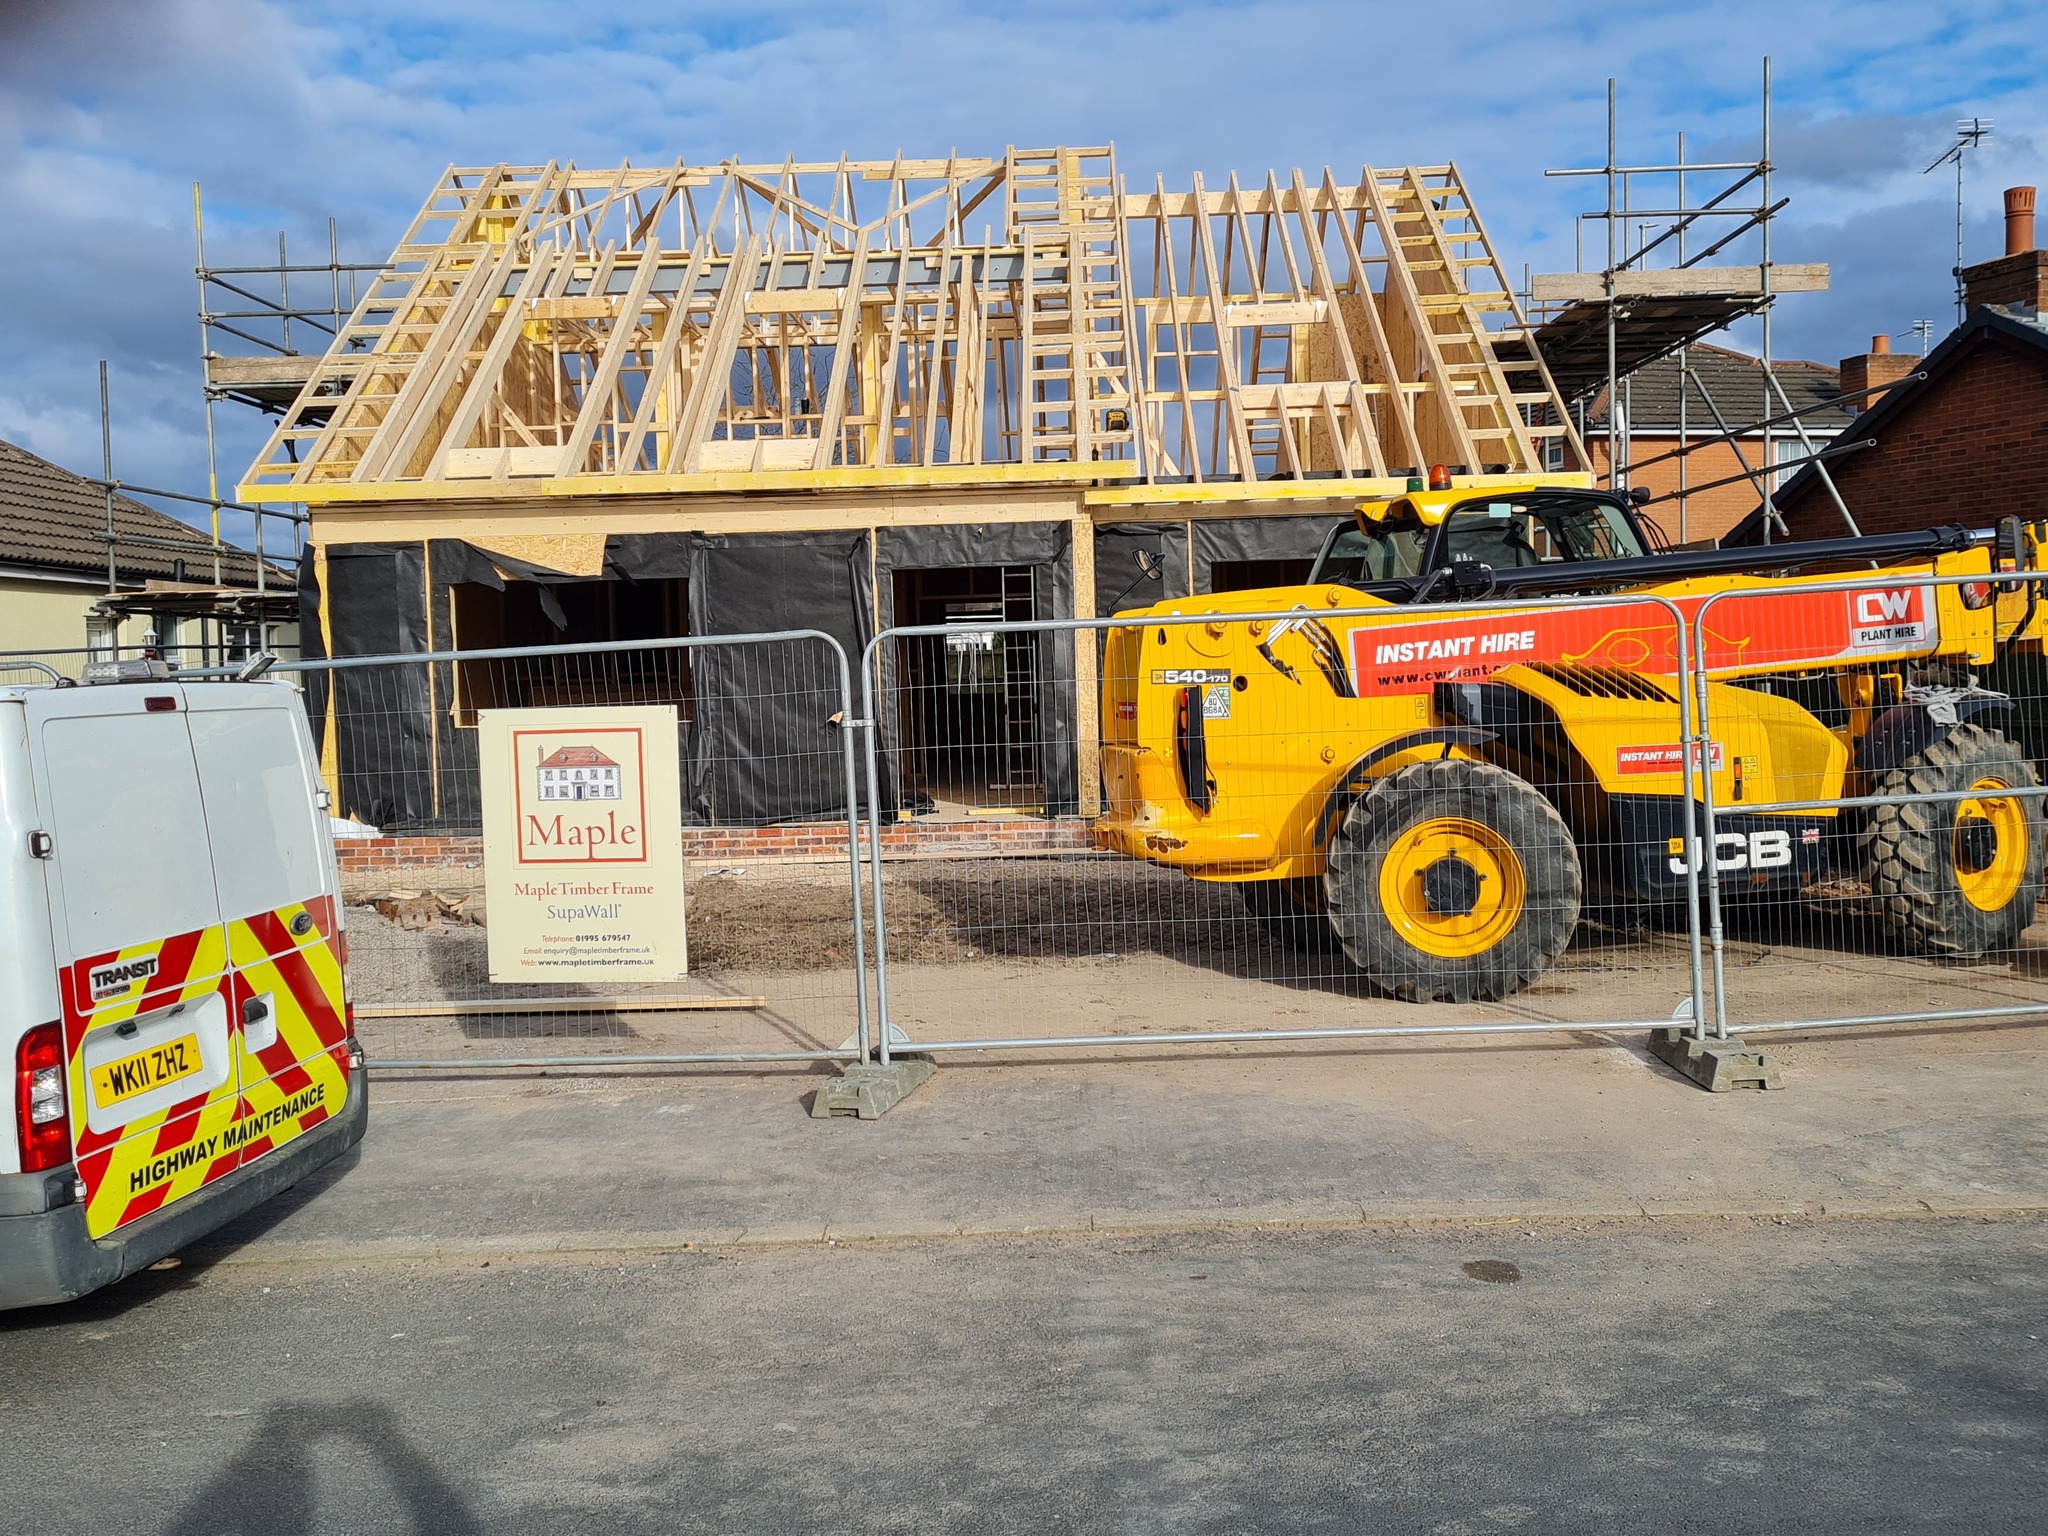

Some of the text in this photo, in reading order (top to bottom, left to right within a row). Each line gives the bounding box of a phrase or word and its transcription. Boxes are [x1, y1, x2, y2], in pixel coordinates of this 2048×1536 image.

[1857, 590, 1911, 623] CW
[1375, 630, 1535, 664] INSTANT HIRE
[1861, 626, 1916, 641] PLANT HIRE
[1620, 750, 1683, 762] INSTANT HIR
[526, 811, 636, 860] Maple
[1669, 830, 1792, 874] JCB
[514, 882, 654, 901] Maple Timber Frame
[542, 935, 574, 943] Telephone:
[602, 934, 630, 942] 679547
[92, 958, 157, 988] TRANSIT
[151, 1043, 189, 1081] ZHZ
[130, 1083, 325, 1193] HIGHWAY MAINTENANCE
